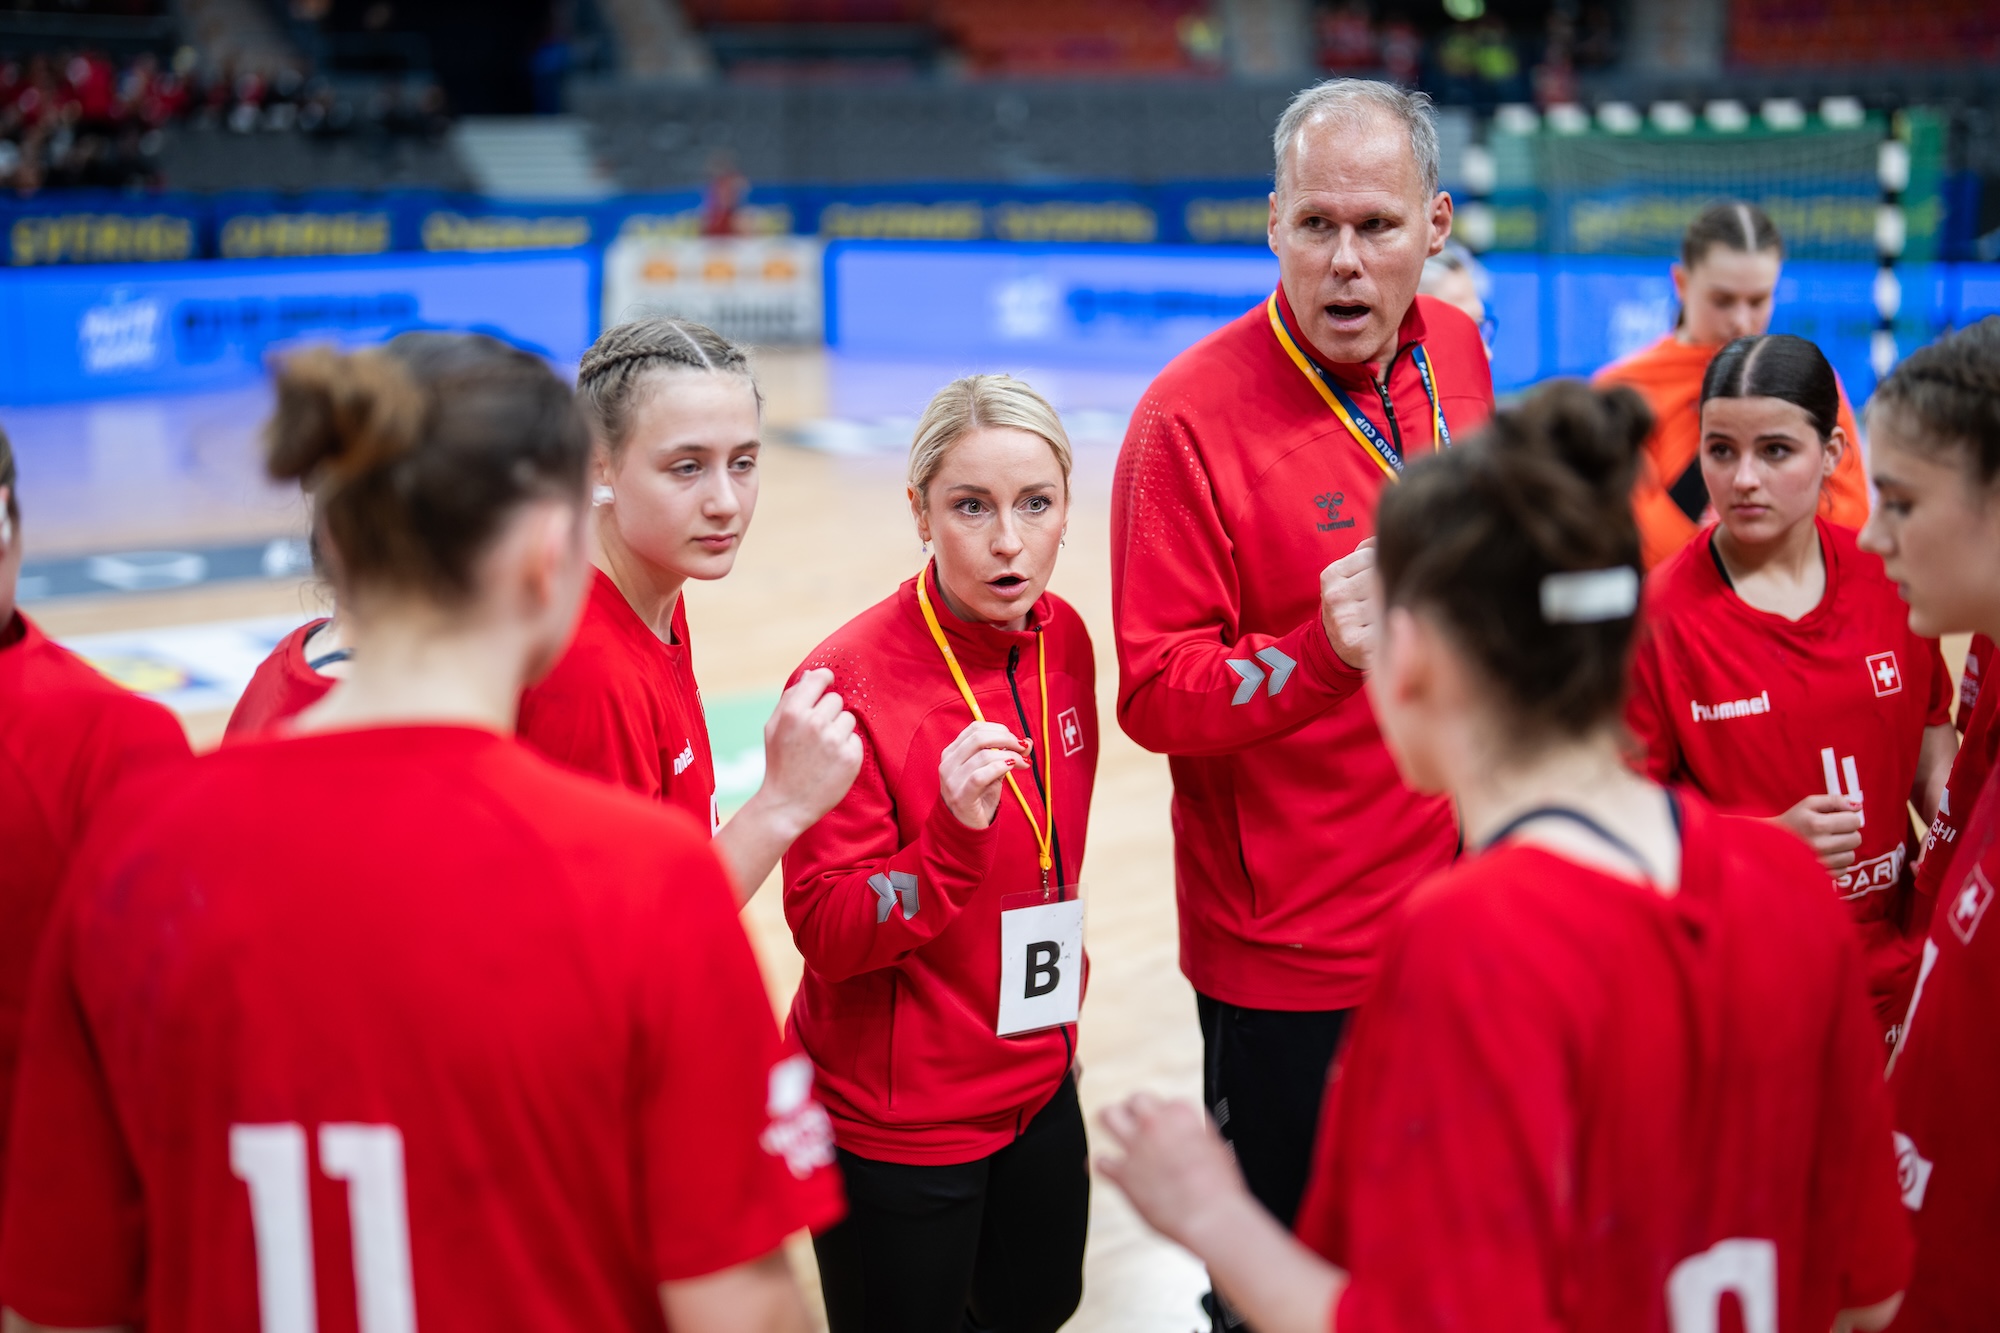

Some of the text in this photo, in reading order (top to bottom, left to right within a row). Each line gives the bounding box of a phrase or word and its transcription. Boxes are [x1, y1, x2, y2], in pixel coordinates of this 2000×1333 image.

[1355, 417, 1404, 473] WORLD CUP
[1690, 690, 1771, 723] hummel
[1831, 860, 1892, 893] PAR
[1024, 940, 1061, 999] B
[227, 1121, 418, 1333] 11
